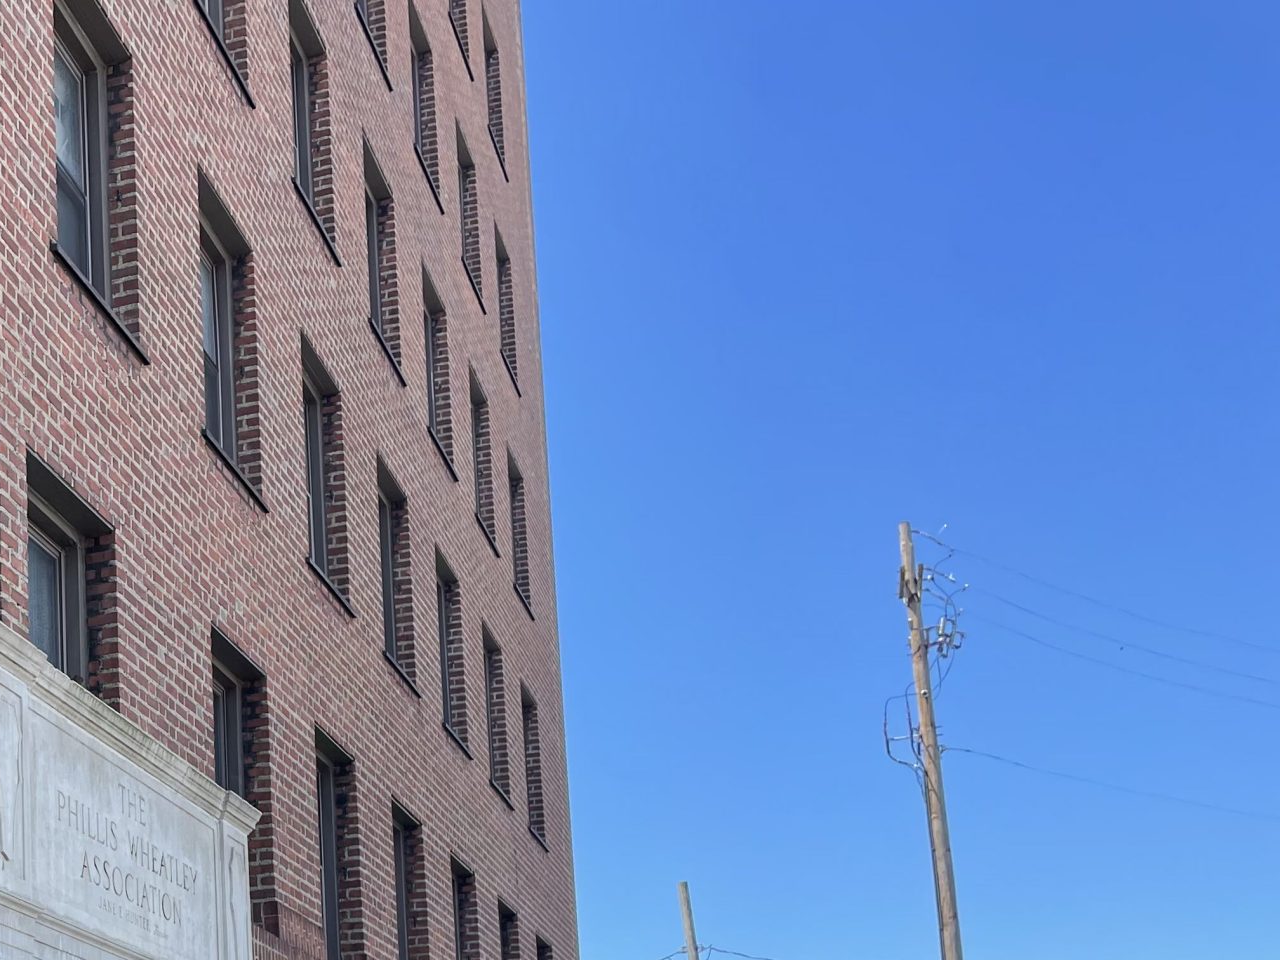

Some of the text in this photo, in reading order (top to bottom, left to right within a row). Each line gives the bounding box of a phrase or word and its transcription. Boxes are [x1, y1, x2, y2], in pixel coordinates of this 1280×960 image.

[57, 790, 199, 896] PHILLIS WHEATLEY
[118, 783, 146, 827] THE
[80, 850, 183, 928] ASSOCIATION
